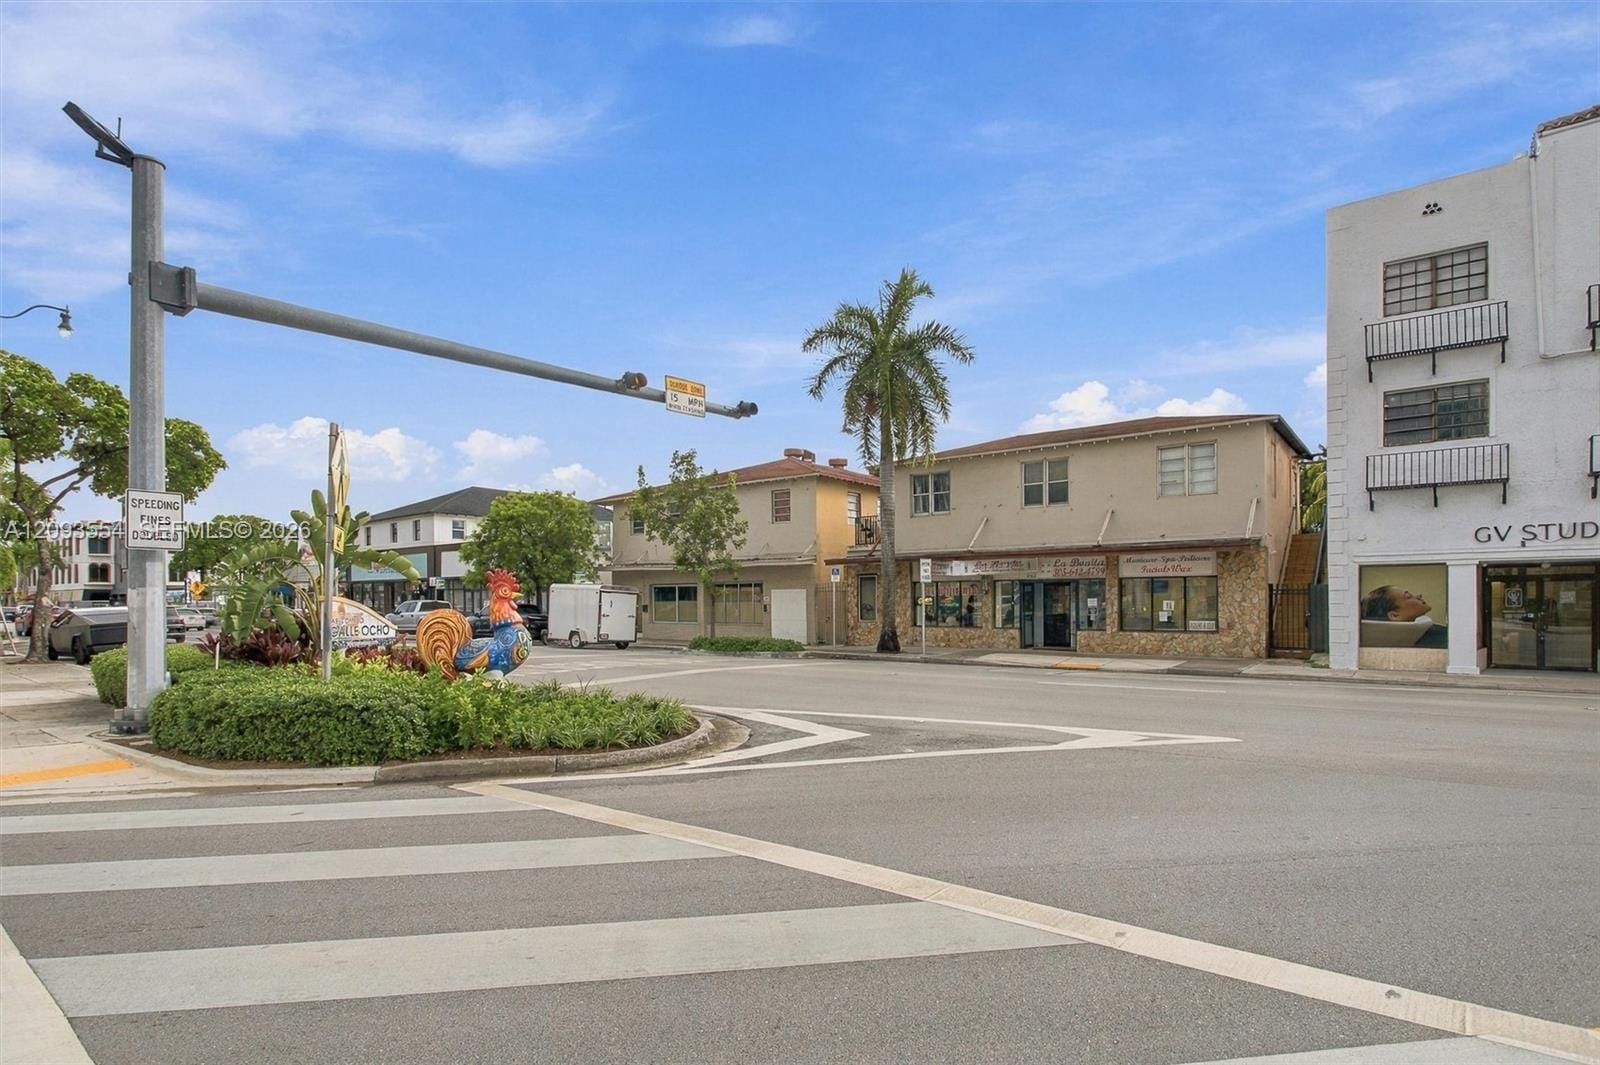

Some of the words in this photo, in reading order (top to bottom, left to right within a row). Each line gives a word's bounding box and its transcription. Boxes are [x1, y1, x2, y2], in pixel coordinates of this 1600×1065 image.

[670, 392, 679, 402] 15
[688, 396, 704, 408] MPH
[131, 498, 180, 510] SPEEDING
[140, 514, 171, 525] FINES
[1474, 525, 1512, 543] GV
[1522, 521, 1599, 541] STUD
[361, 624, 390, 636] OCHO
